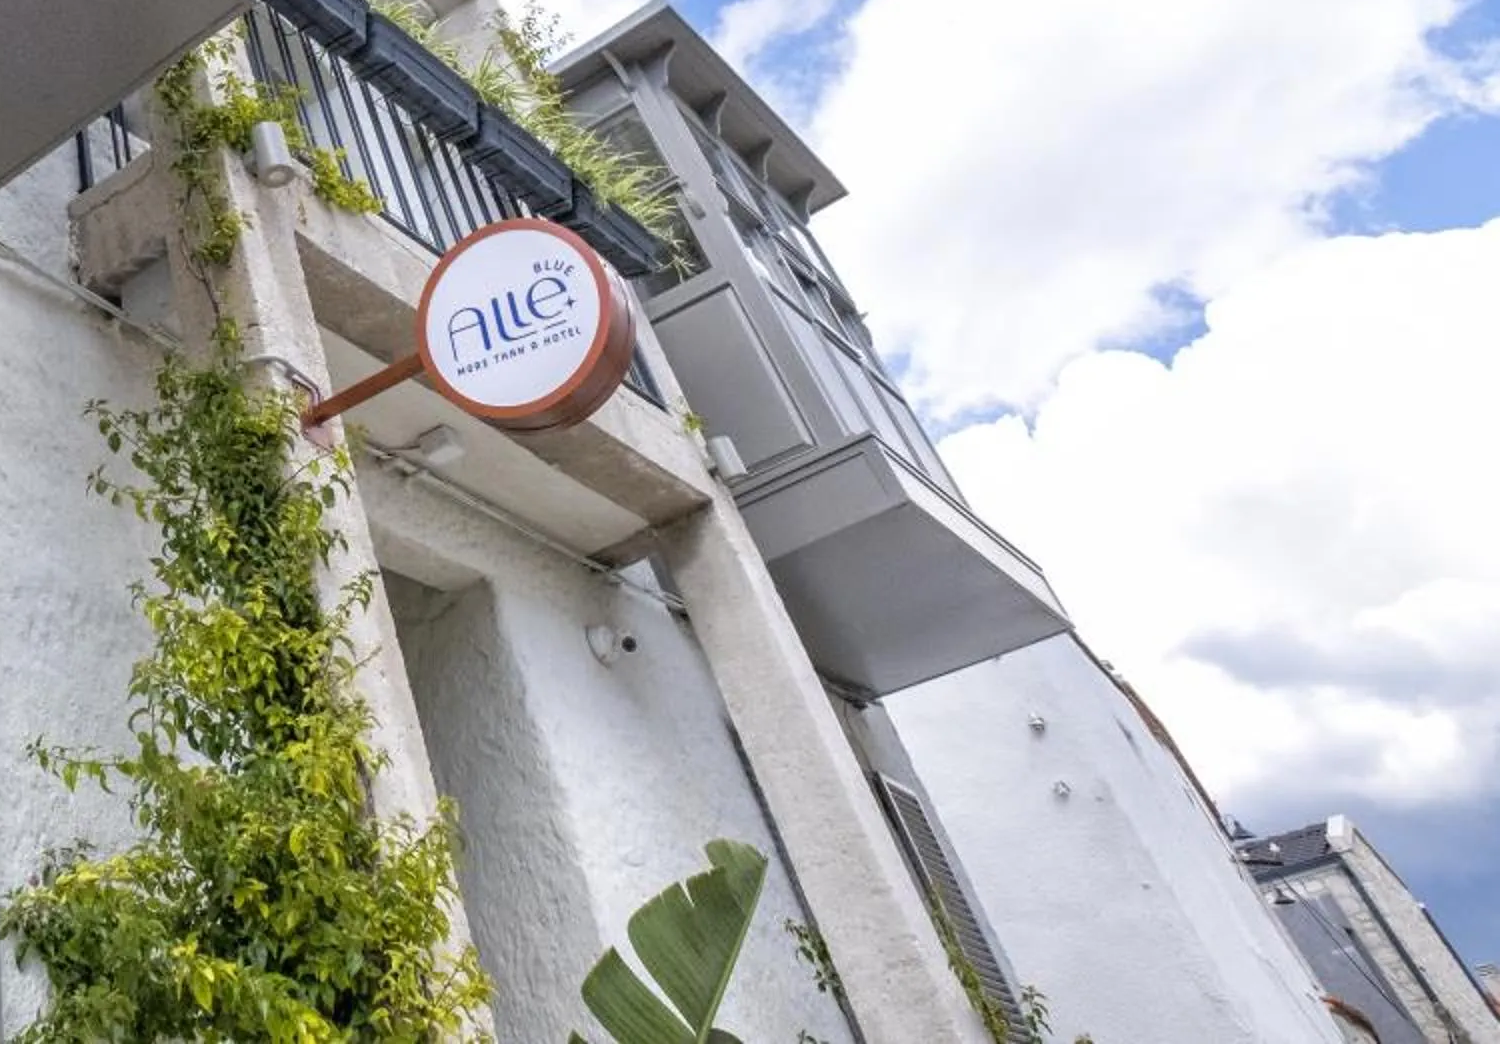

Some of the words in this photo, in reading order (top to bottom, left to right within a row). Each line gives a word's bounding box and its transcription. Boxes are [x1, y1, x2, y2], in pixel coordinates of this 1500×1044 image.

[533, 258, 575, 277] BLUE
[457, 359, 489, 377] MORE
[493, 345, 526, 365] THAN
[530, 341, 539, 351] A
[543, 326, 582, 346] HOTEL
